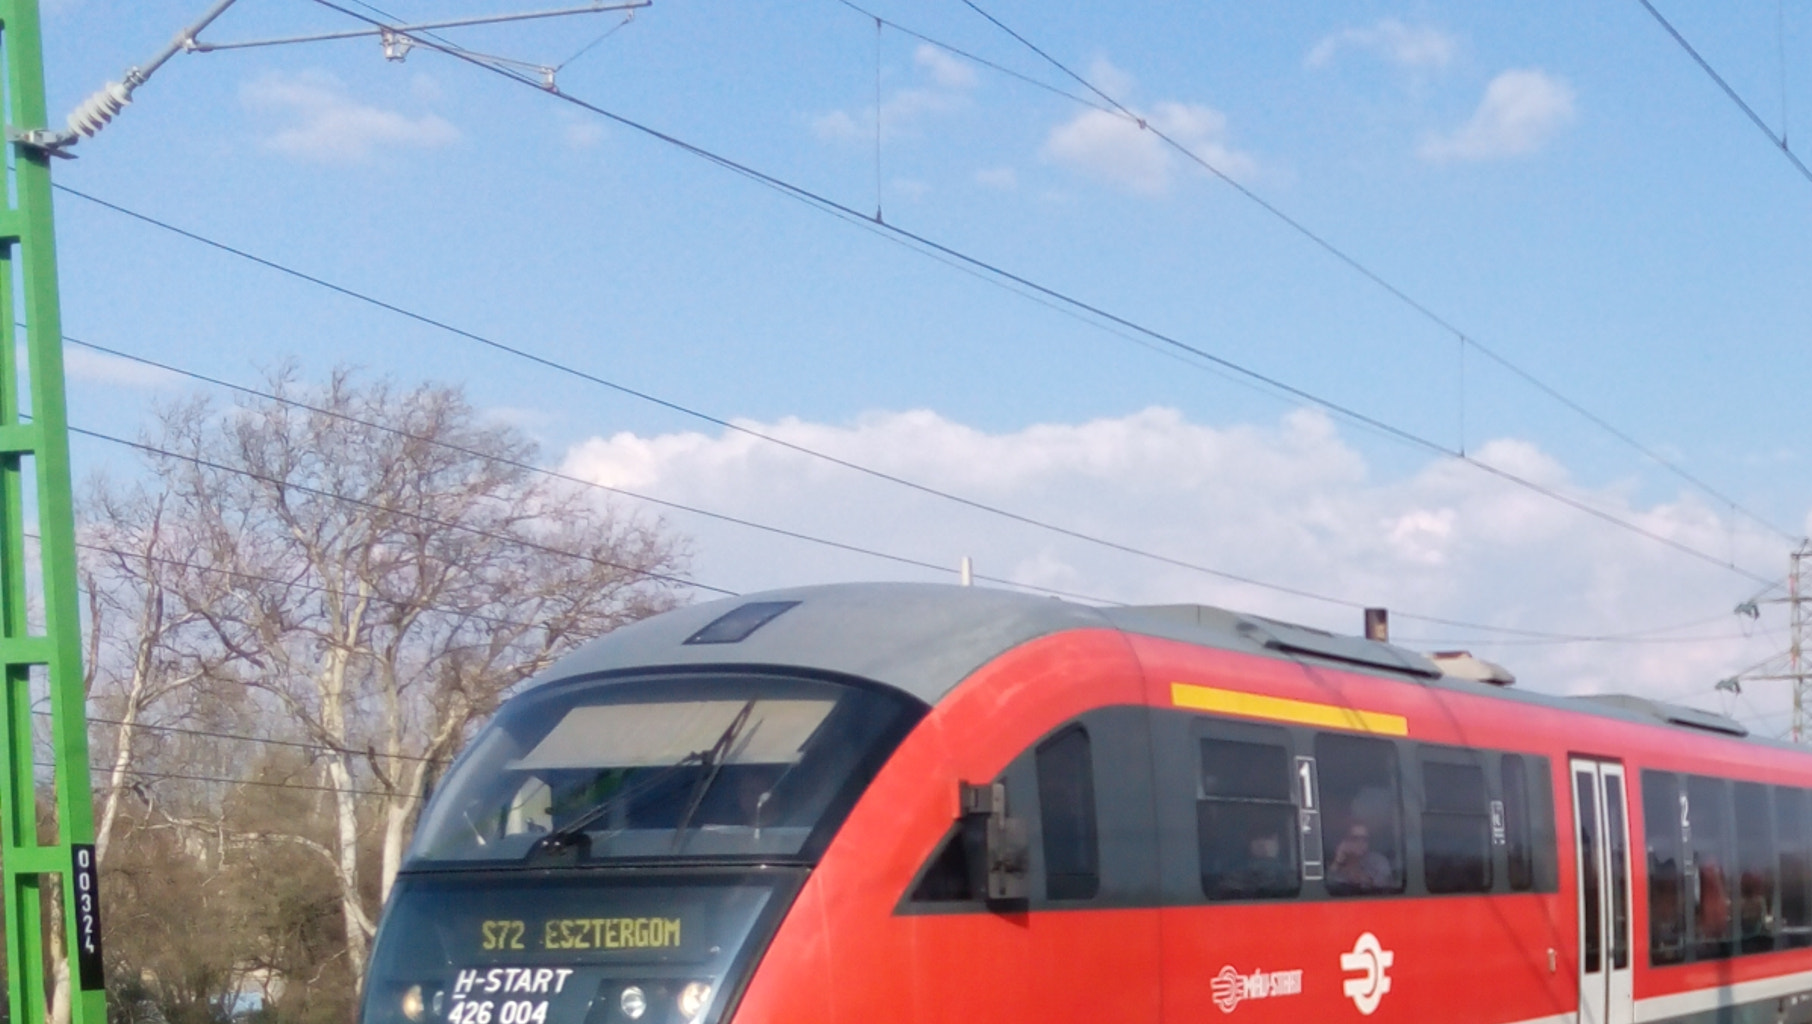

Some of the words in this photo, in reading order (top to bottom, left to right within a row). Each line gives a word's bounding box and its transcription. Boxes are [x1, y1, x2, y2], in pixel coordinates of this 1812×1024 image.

[1300, 762, 1313, 808] 1
[78, 849, 95, 953] 00324
[482, 920, 526, 949] S72
[545, 917, 681, 949] ESZTERGOM
[453, 968, 574, 997] H-START
